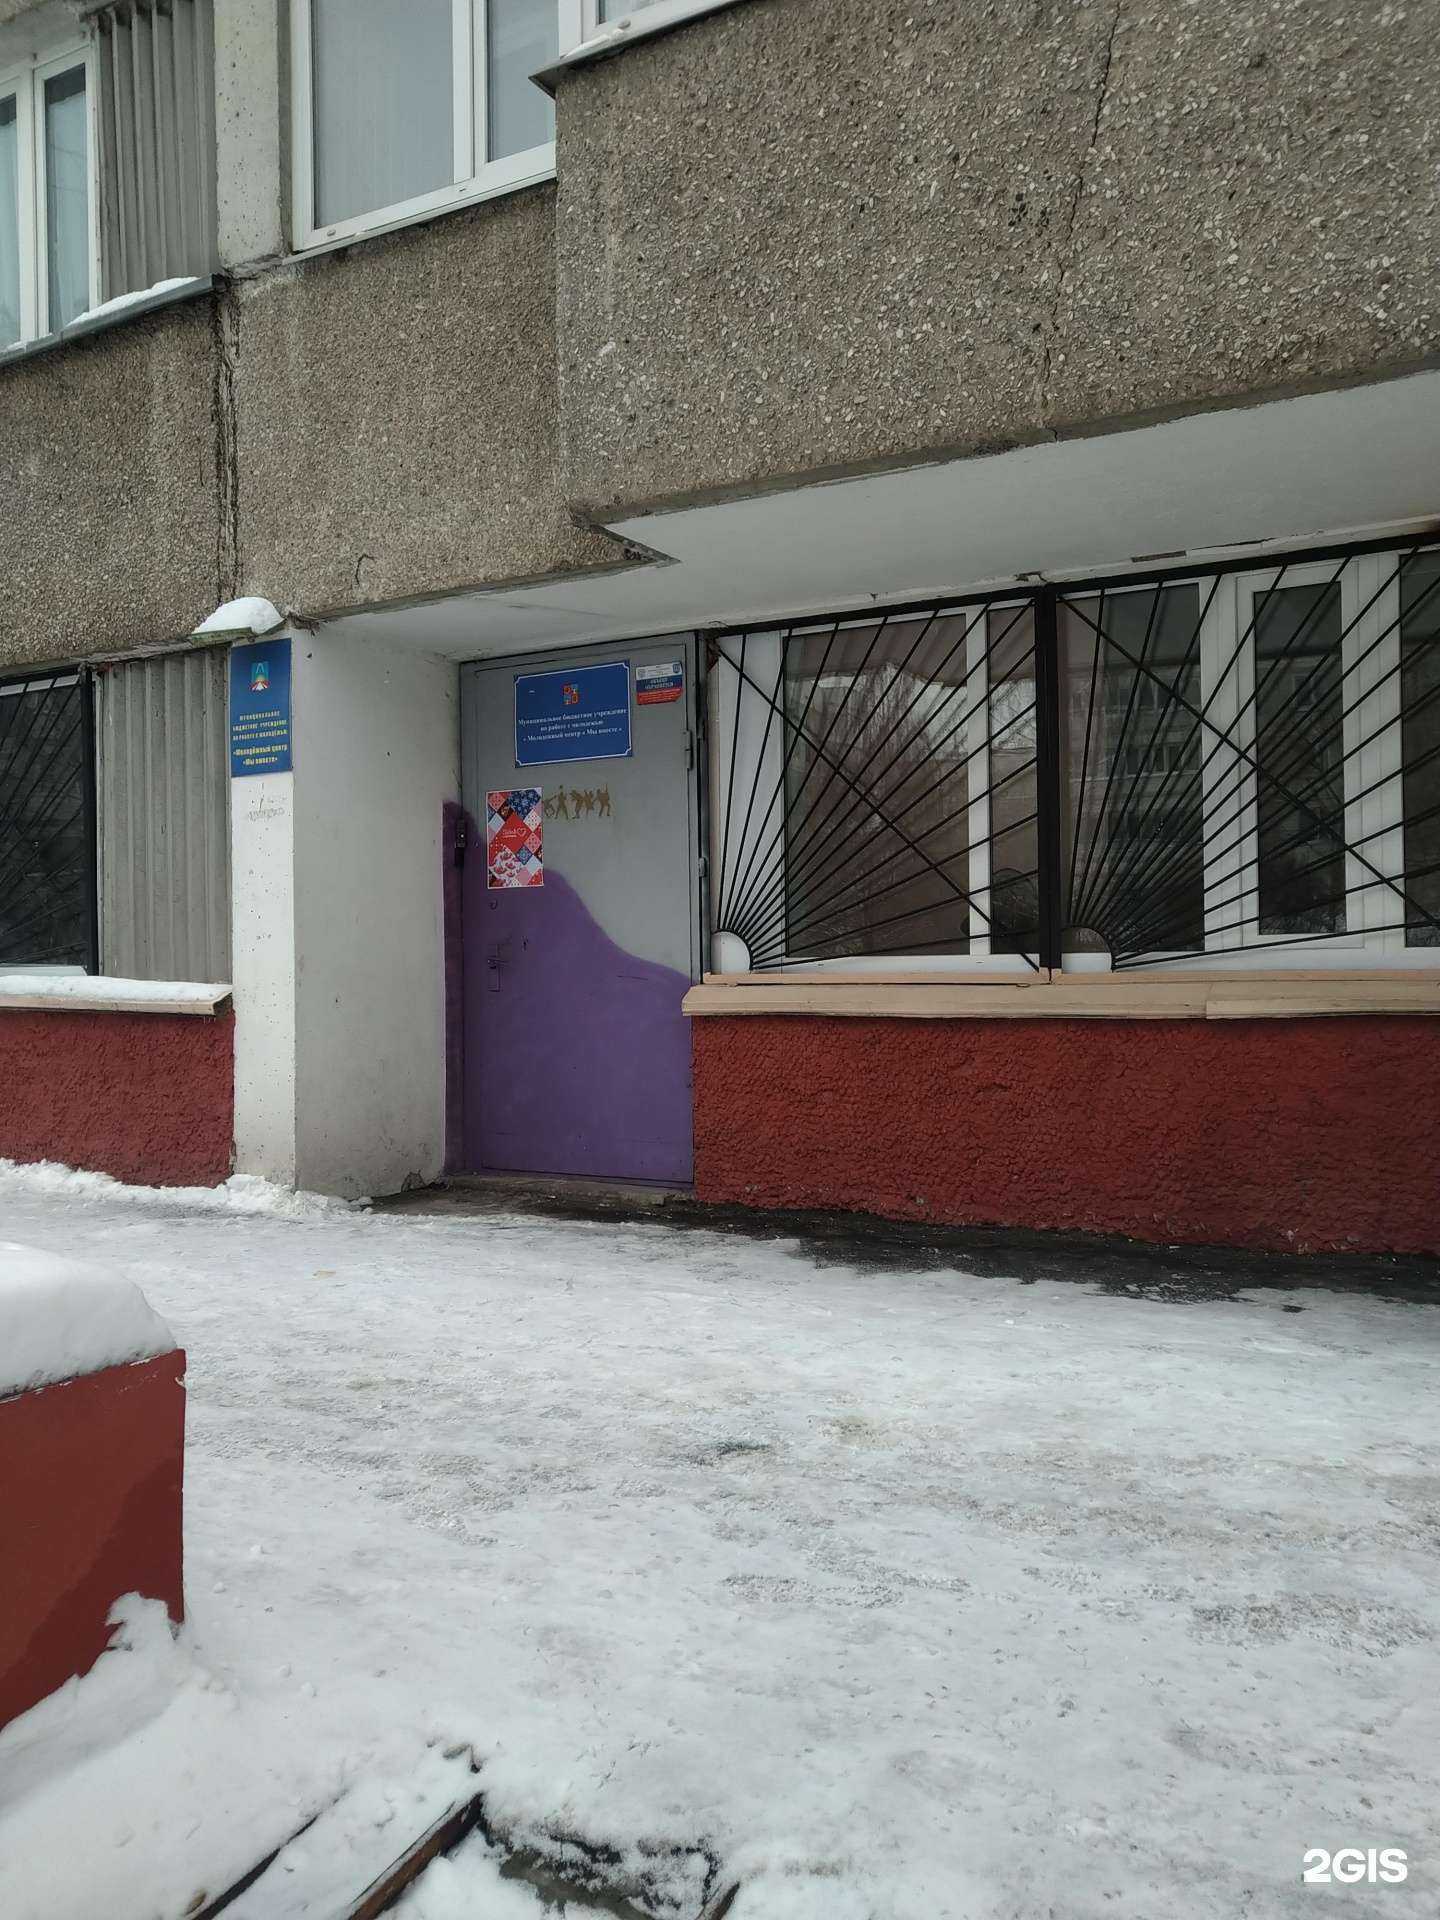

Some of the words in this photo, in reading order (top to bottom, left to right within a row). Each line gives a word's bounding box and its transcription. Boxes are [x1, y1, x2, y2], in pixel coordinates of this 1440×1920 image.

[518, 716, 561, 727] Муниципальное
[562, 711, 592, 721] бюджетное
[593, 708, 628, 718] учреждение
[548, 723, 566, 733] работе
[564, 729, 581, 740] центр
[586, 728, 598, 736] Мы
[598, 726, 618, 735] вместе
[272, 744, 288, 752] центр
